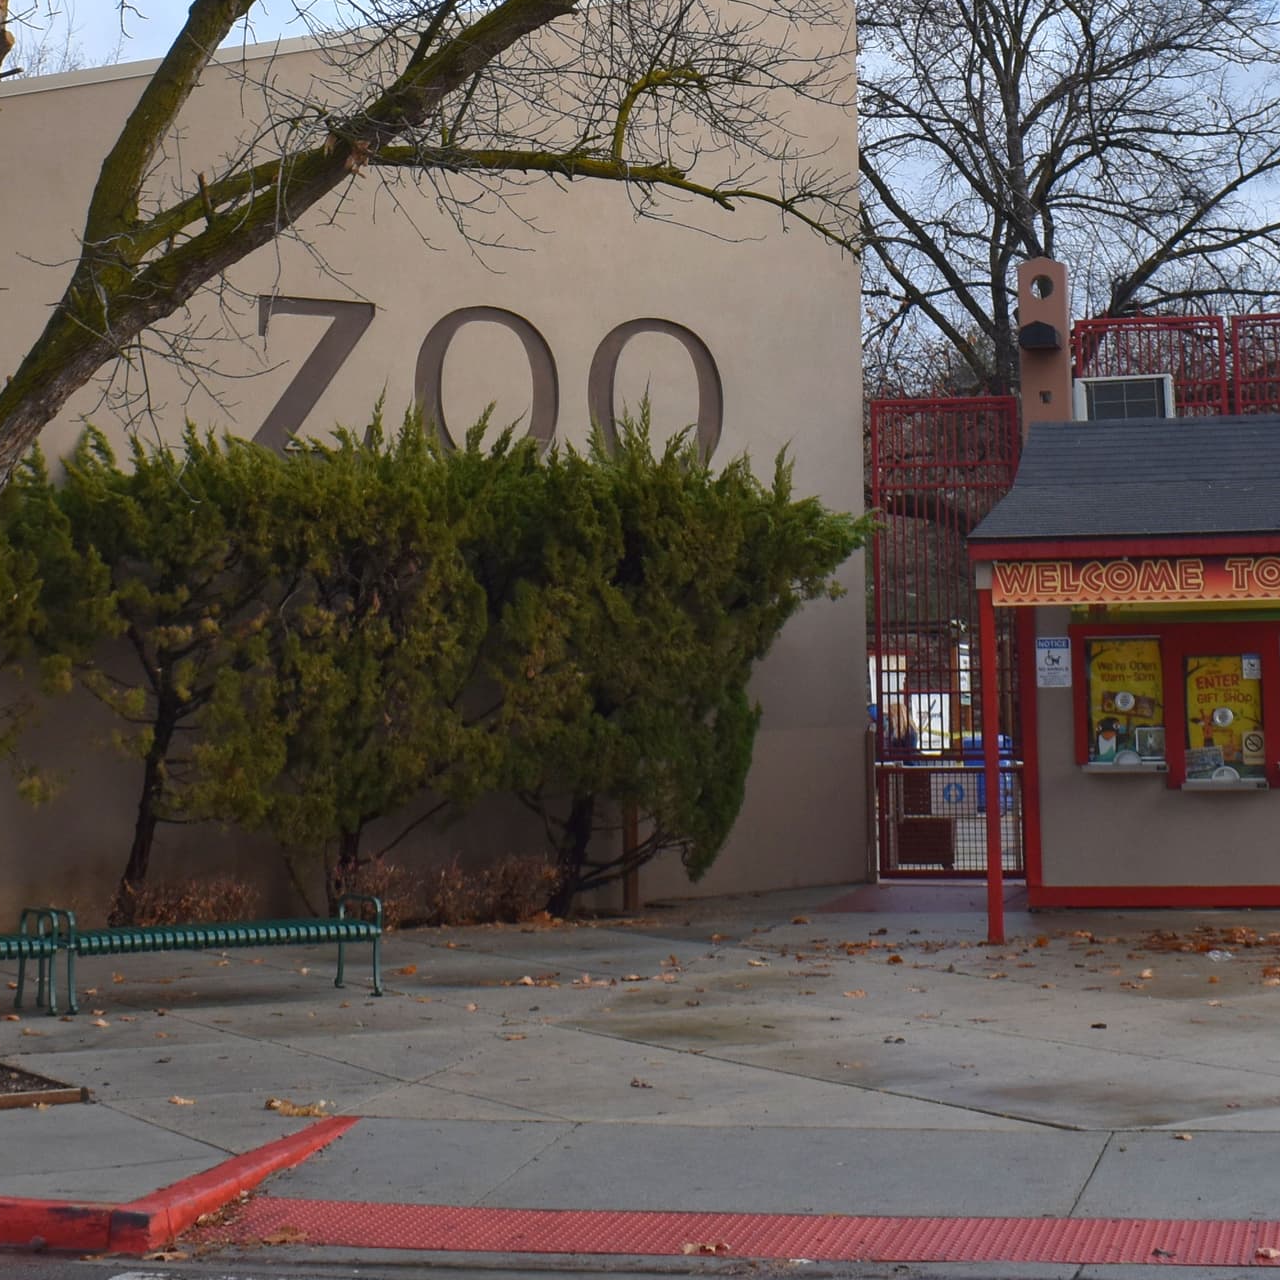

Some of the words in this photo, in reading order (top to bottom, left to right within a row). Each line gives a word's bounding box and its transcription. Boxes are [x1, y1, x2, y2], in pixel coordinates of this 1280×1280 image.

[258, 294, 723, 465] ZOO
[995, 559, 1204, 596] WELCOME
[1038, 639, 1067, 648] NOTICE
[1196, 673, 1240, 689] ENTER
[1197, 693, 1218, 705] GIFT
[1224, 692, 1253, 704] SHOP
